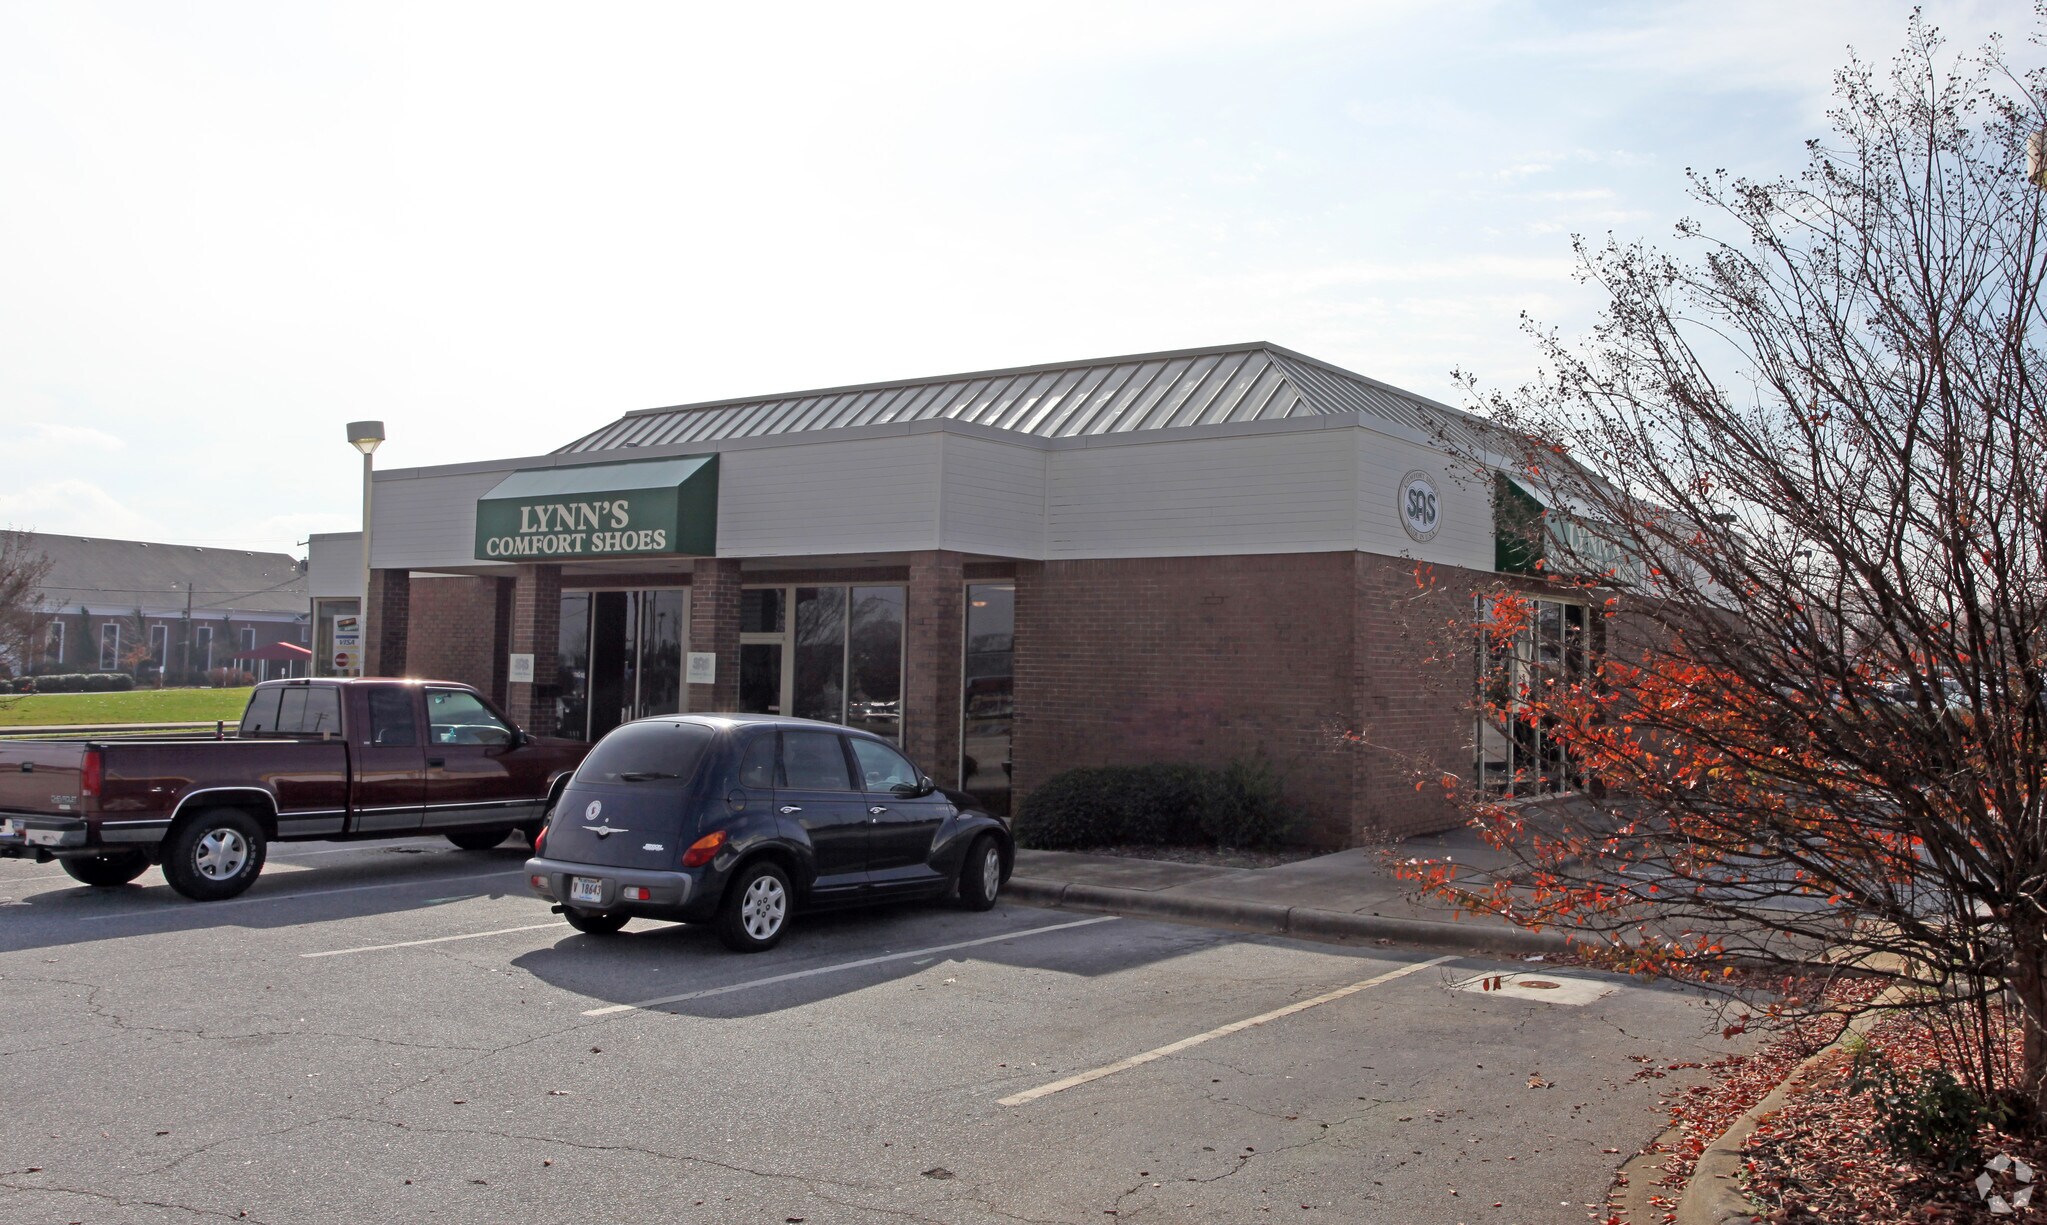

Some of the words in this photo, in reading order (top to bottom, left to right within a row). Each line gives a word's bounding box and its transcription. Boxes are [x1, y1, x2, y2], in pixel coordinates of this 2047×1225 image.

[519, 499, 629, 533] LYNN'S
[1406, 488, 1436, 526] SAS
[486, 532, 586, 556] COMFORT
[591, 529, 666, 552] SHOES
[1568, 523, 1621, 558] LYNNS
[573, 882, 579, 893] V
[581, 883, 602, 897] 18643
